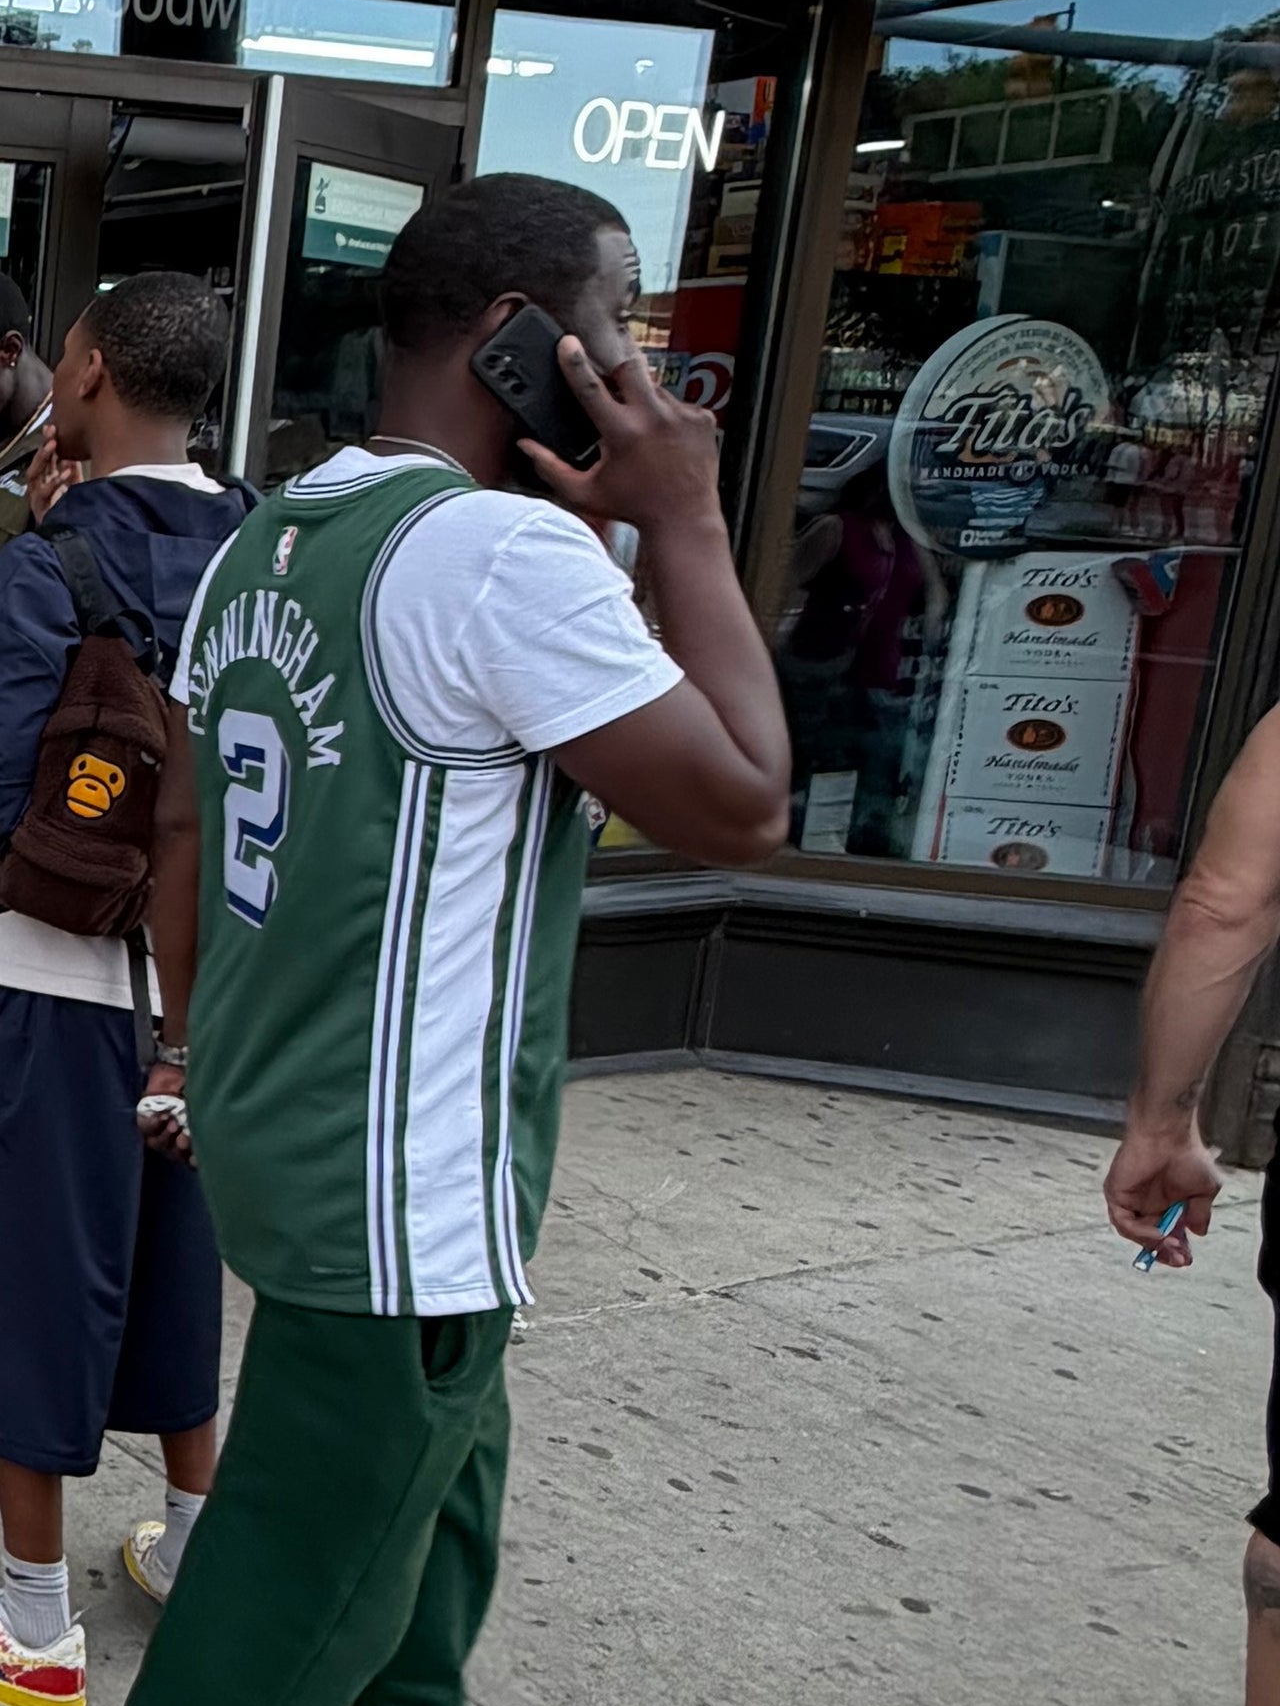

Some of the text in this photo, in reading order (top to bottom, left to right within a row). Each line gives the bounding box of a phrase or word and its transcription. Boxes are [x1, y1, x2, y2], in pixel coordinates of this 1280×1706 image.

[573, 96, 726, 173] OPEN
[934, 385, 1093, 455] Tito's
[1023, 567, 1098, 589] Tito's
[1003, 629, 1098, 647] Handmade
[187, 589, 345, 772] CUNNINGHAM
[1002, 692, 1079, 715] Tito's
[985, 754, 1081, 773] Handmade
[216, 708, 292, 930] 2
[986, 817, 1063, 839] Tito's
